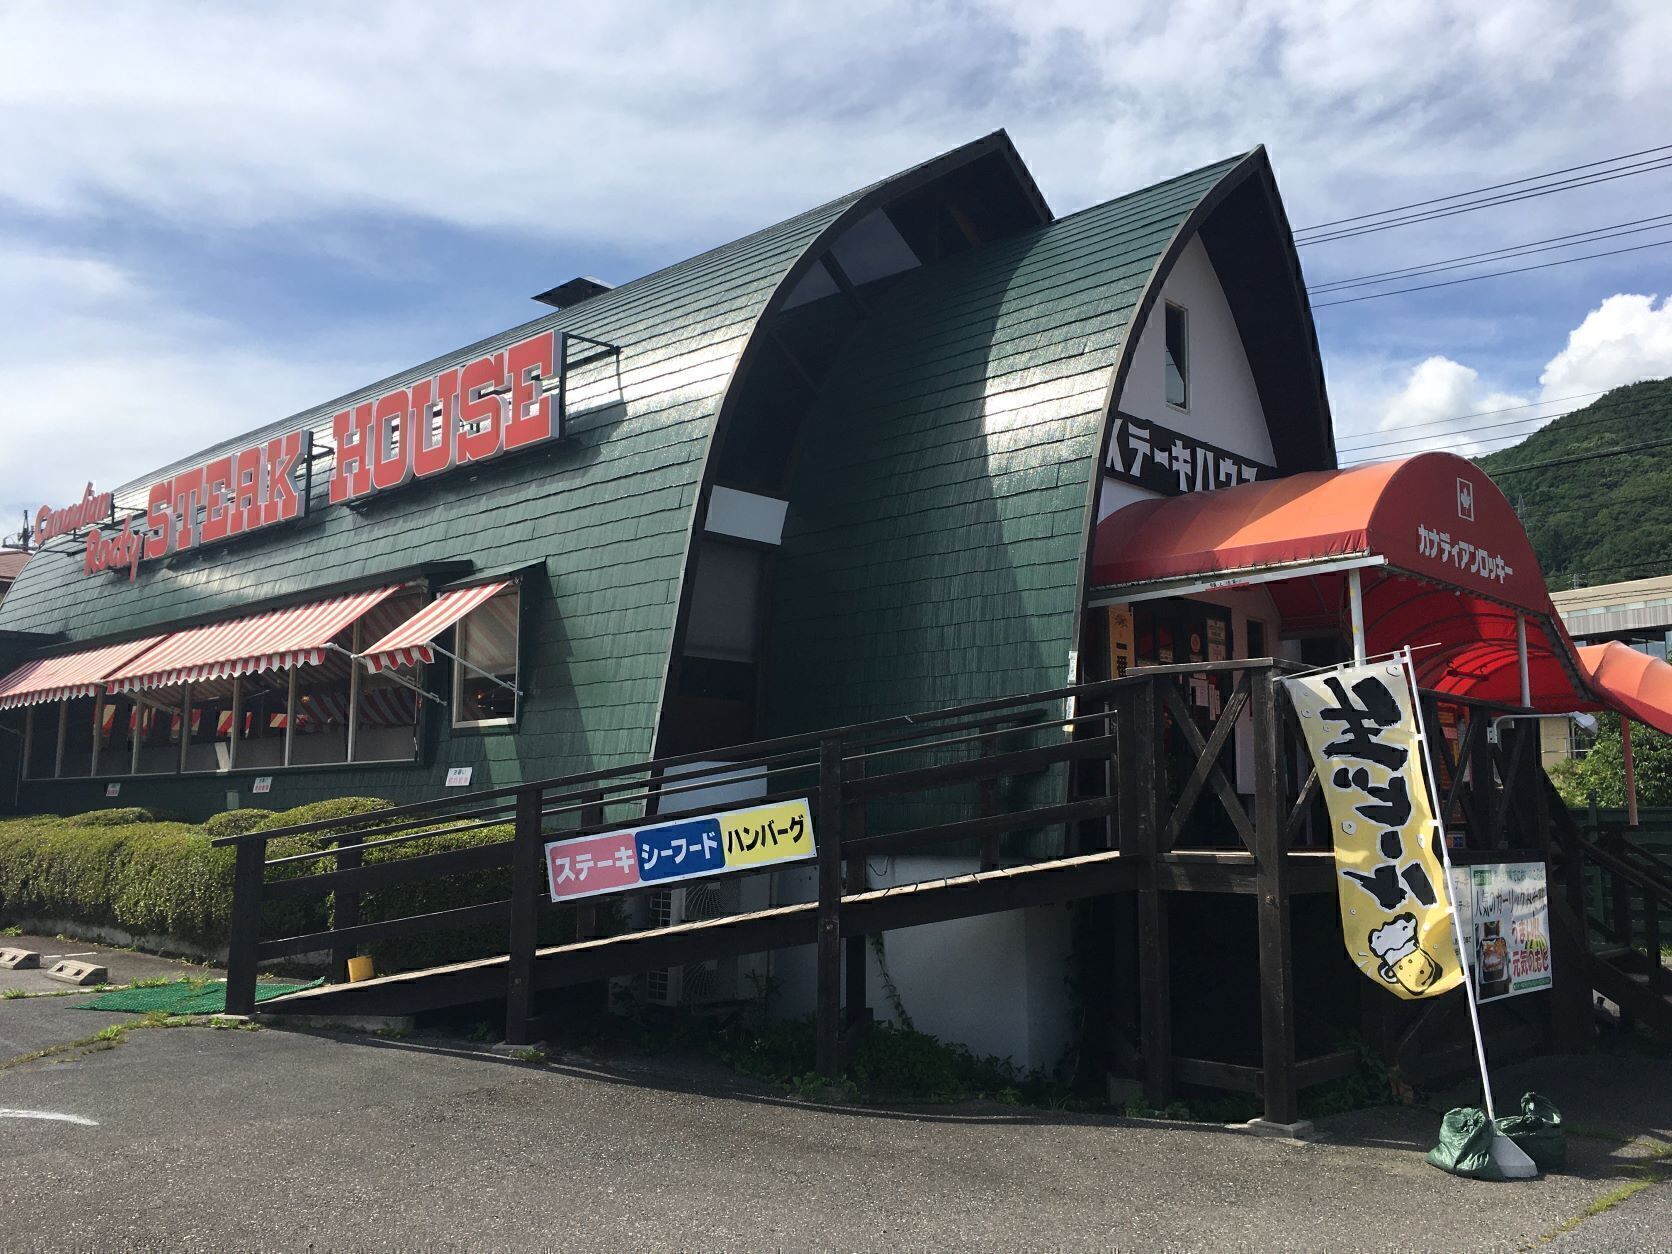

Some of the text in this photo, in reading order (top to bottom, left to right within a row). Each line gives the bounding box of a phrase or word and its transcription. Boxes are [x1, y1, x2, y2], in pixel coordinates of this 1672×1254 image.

[142, 330, 558, 559] STEAK HOUSE
[84, 513, 142, 586] Rocky
[1418, 523, 1513, 584] カナディアンロッキー
[555, 814, 805, 885] ステーキ シーフード ハンバーグ
